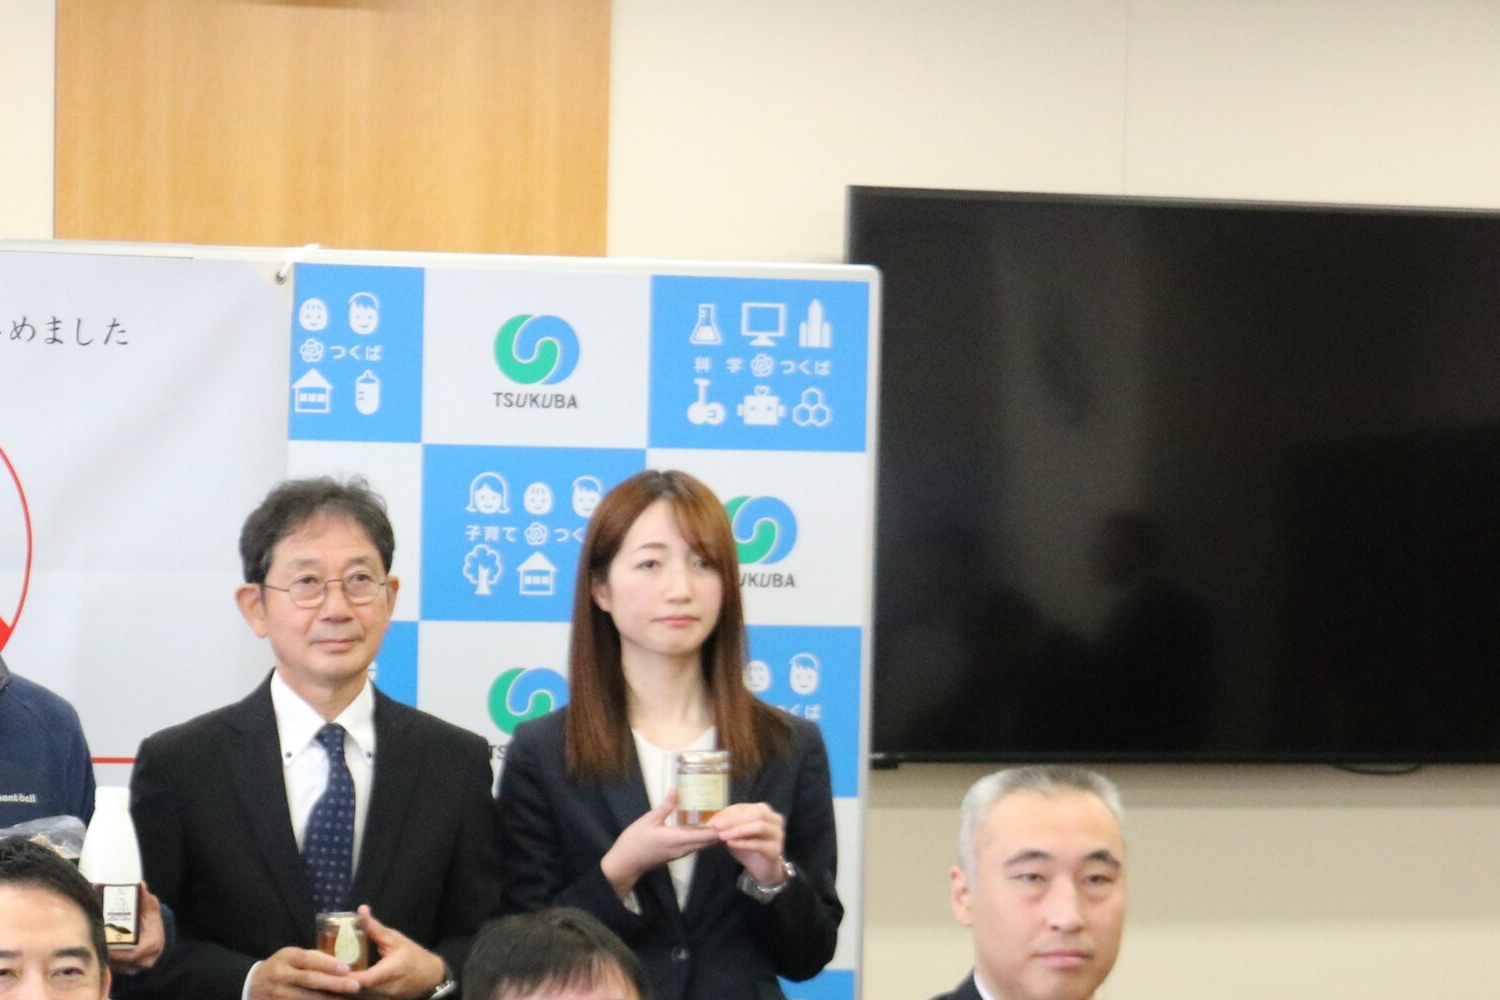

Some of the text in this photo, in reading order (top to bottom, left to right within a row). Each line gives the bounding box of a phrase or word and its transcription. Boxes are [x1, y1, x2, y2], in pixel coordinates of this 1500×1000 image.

[329, 344, 383, 361] つくば
[779, 360, 831, 376] つくば
[492, 392, 578, 409] TSUKUBA
[464, 524, 518, 542] 子育て
[776, 704, 822, 720] くば
